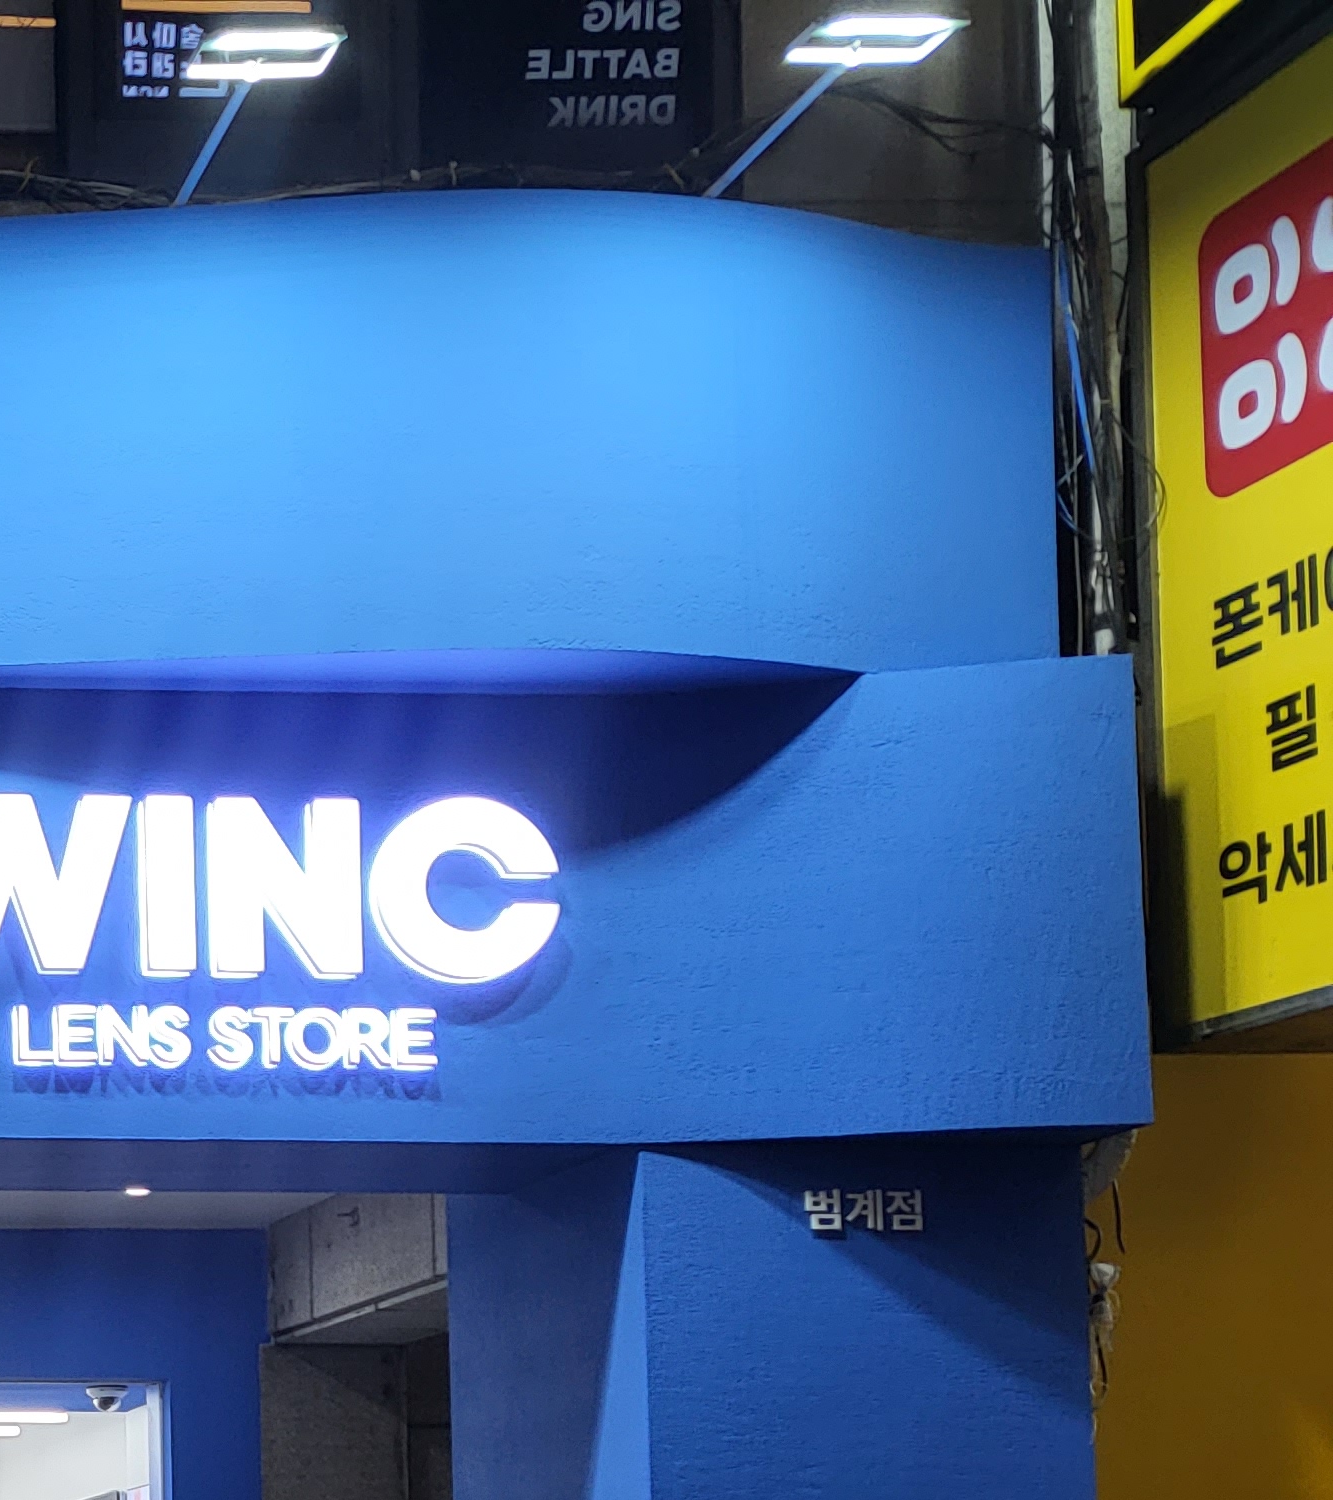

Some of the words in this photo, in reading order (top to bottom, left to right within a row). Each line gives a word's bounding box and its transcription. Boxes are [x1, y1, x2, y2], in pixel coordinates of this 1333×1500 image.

[1214, 197, 1333, 336] 이
[1219, 318, 1333, 451] 이
[1211, 548, 1333, 670] 폰케
[1217, 805, 1333, 905] 악세
[10, 1004, 193, 1070] LENS
[207, 1004, 439, 1072] STORE
[803, 1188, 924, 1232] 범계점
